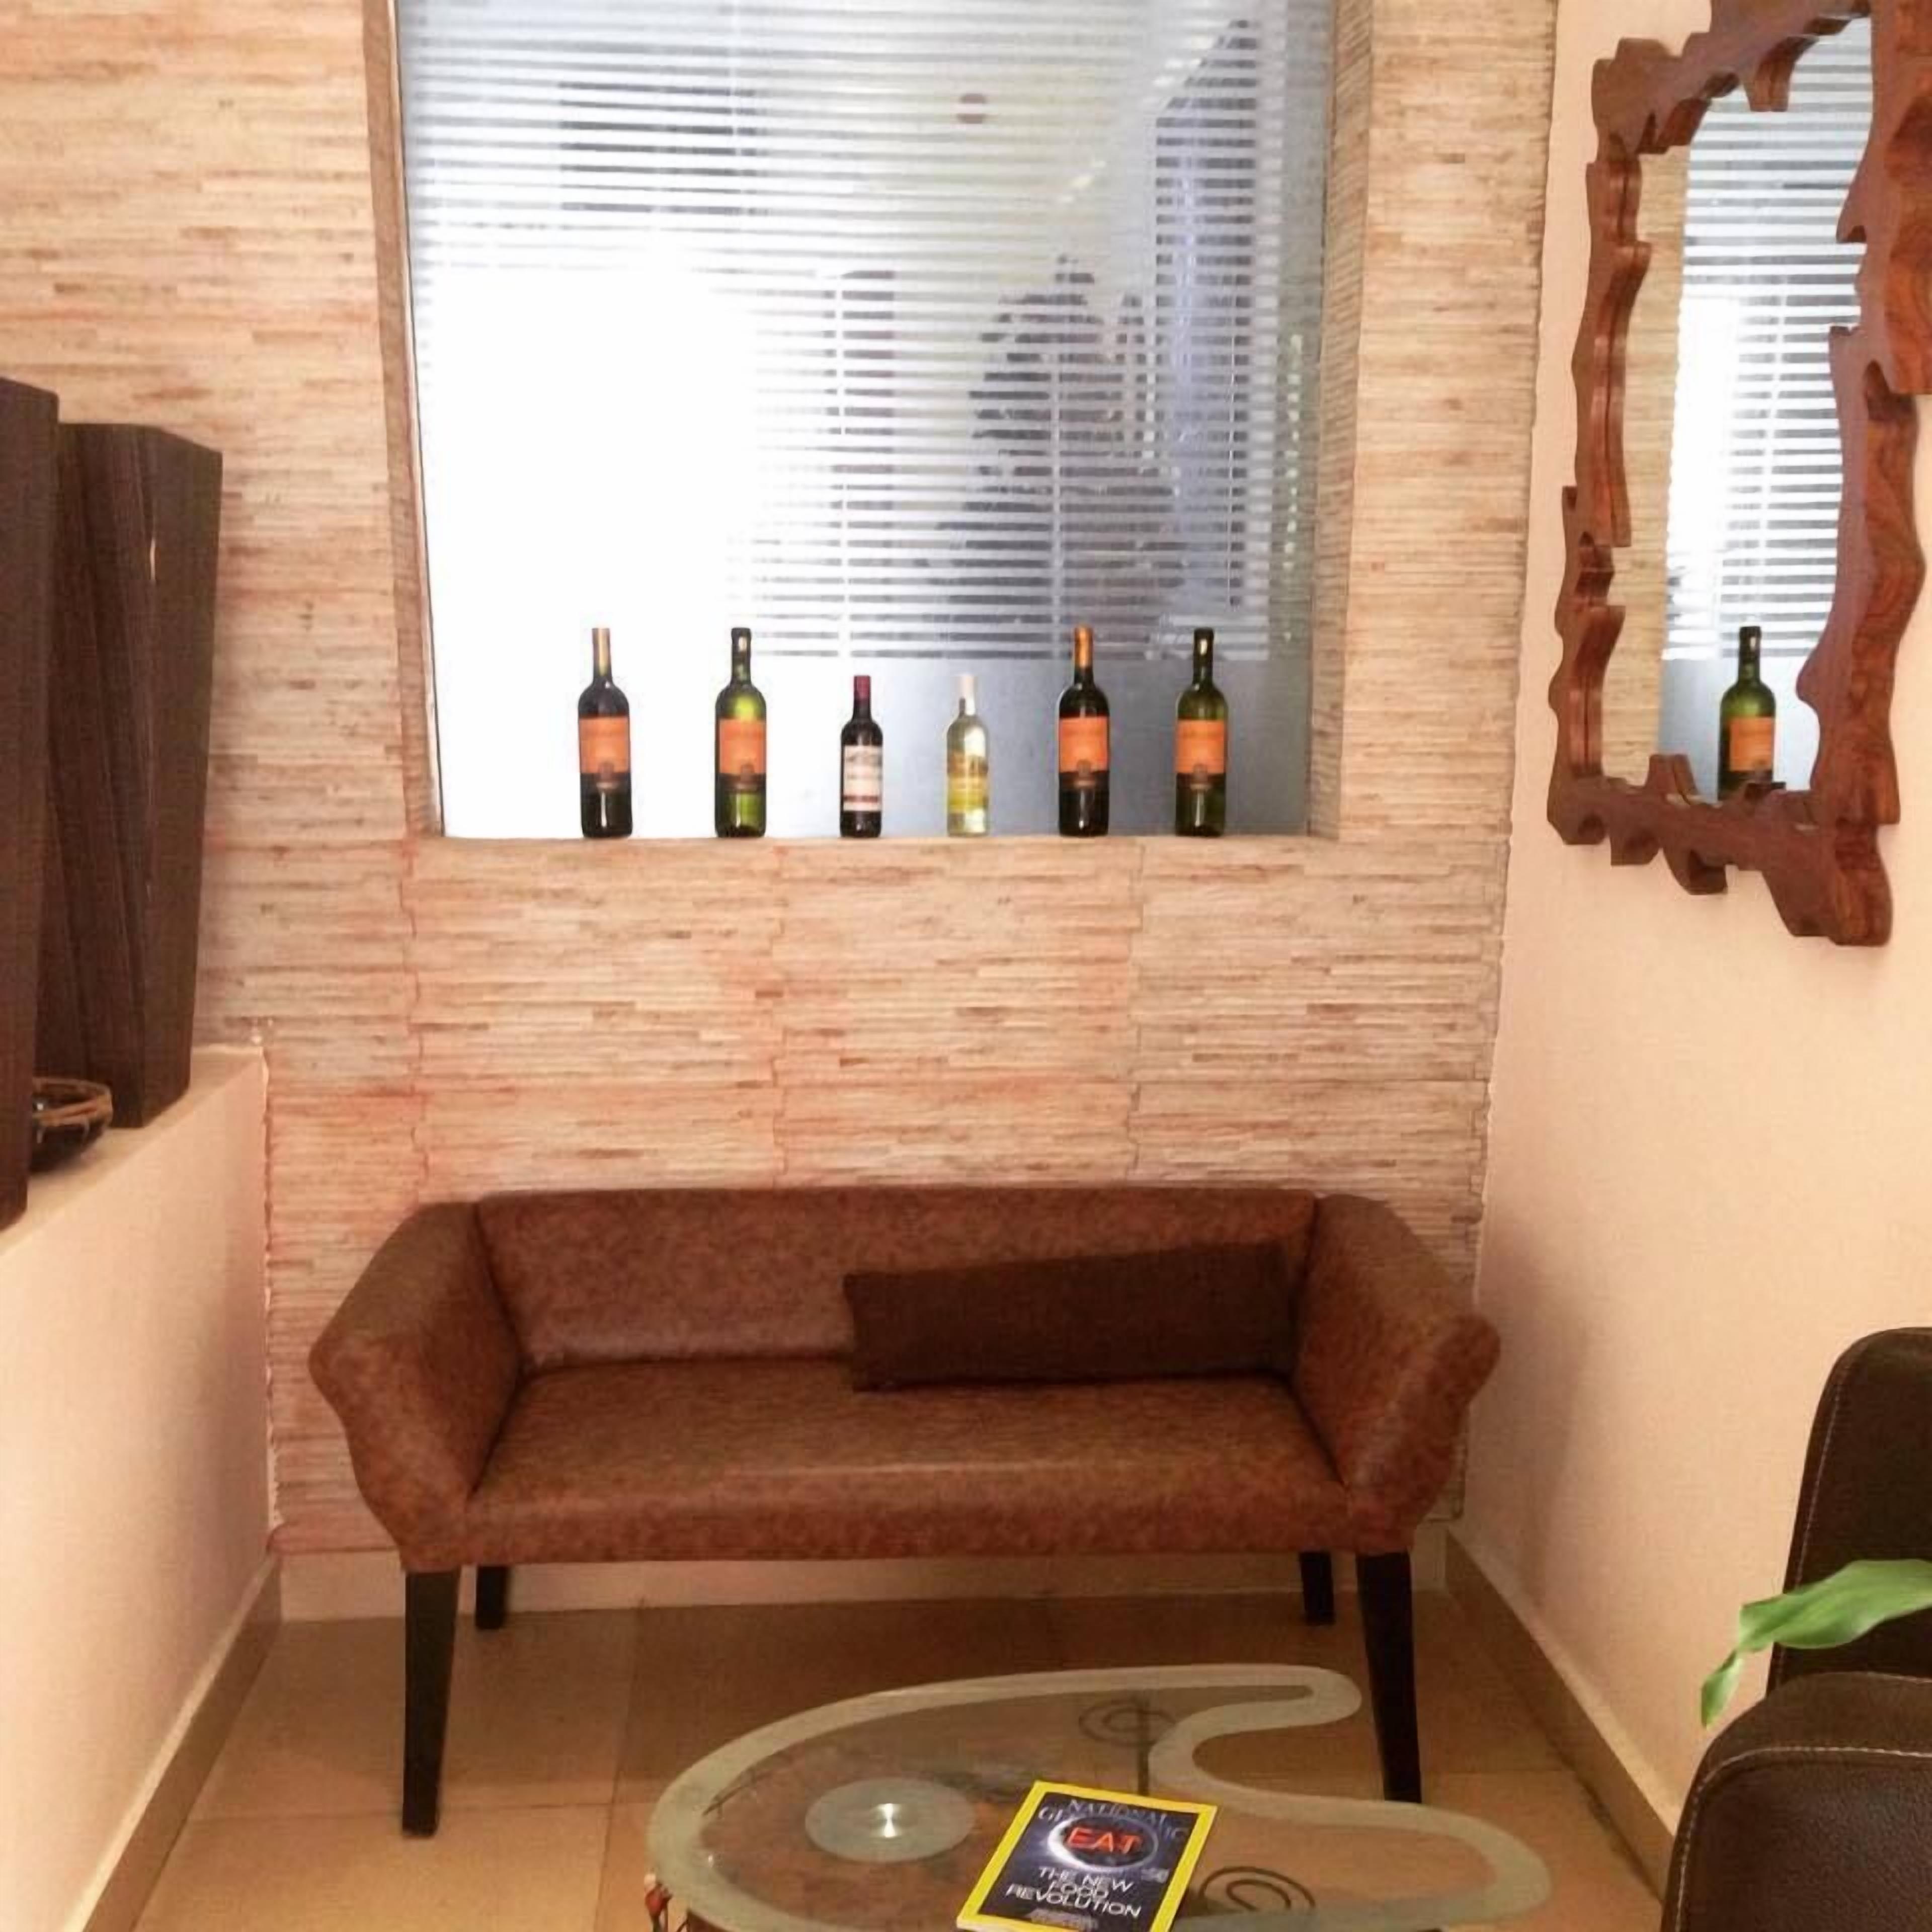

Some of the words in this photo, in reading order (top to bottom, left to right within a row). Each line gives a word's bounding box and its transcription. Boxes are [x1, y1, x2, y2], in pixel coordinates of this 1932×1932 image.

[1067, 1826, 1142, 1854] EAT
[1038, 1866, 1077, 1882] THE
[1082, 1874, 1134, 1893] NEW
[1047, 1880, 1109, 1900] FOOD
[1005, 1883, 1142, 1918] REVOLUTION
